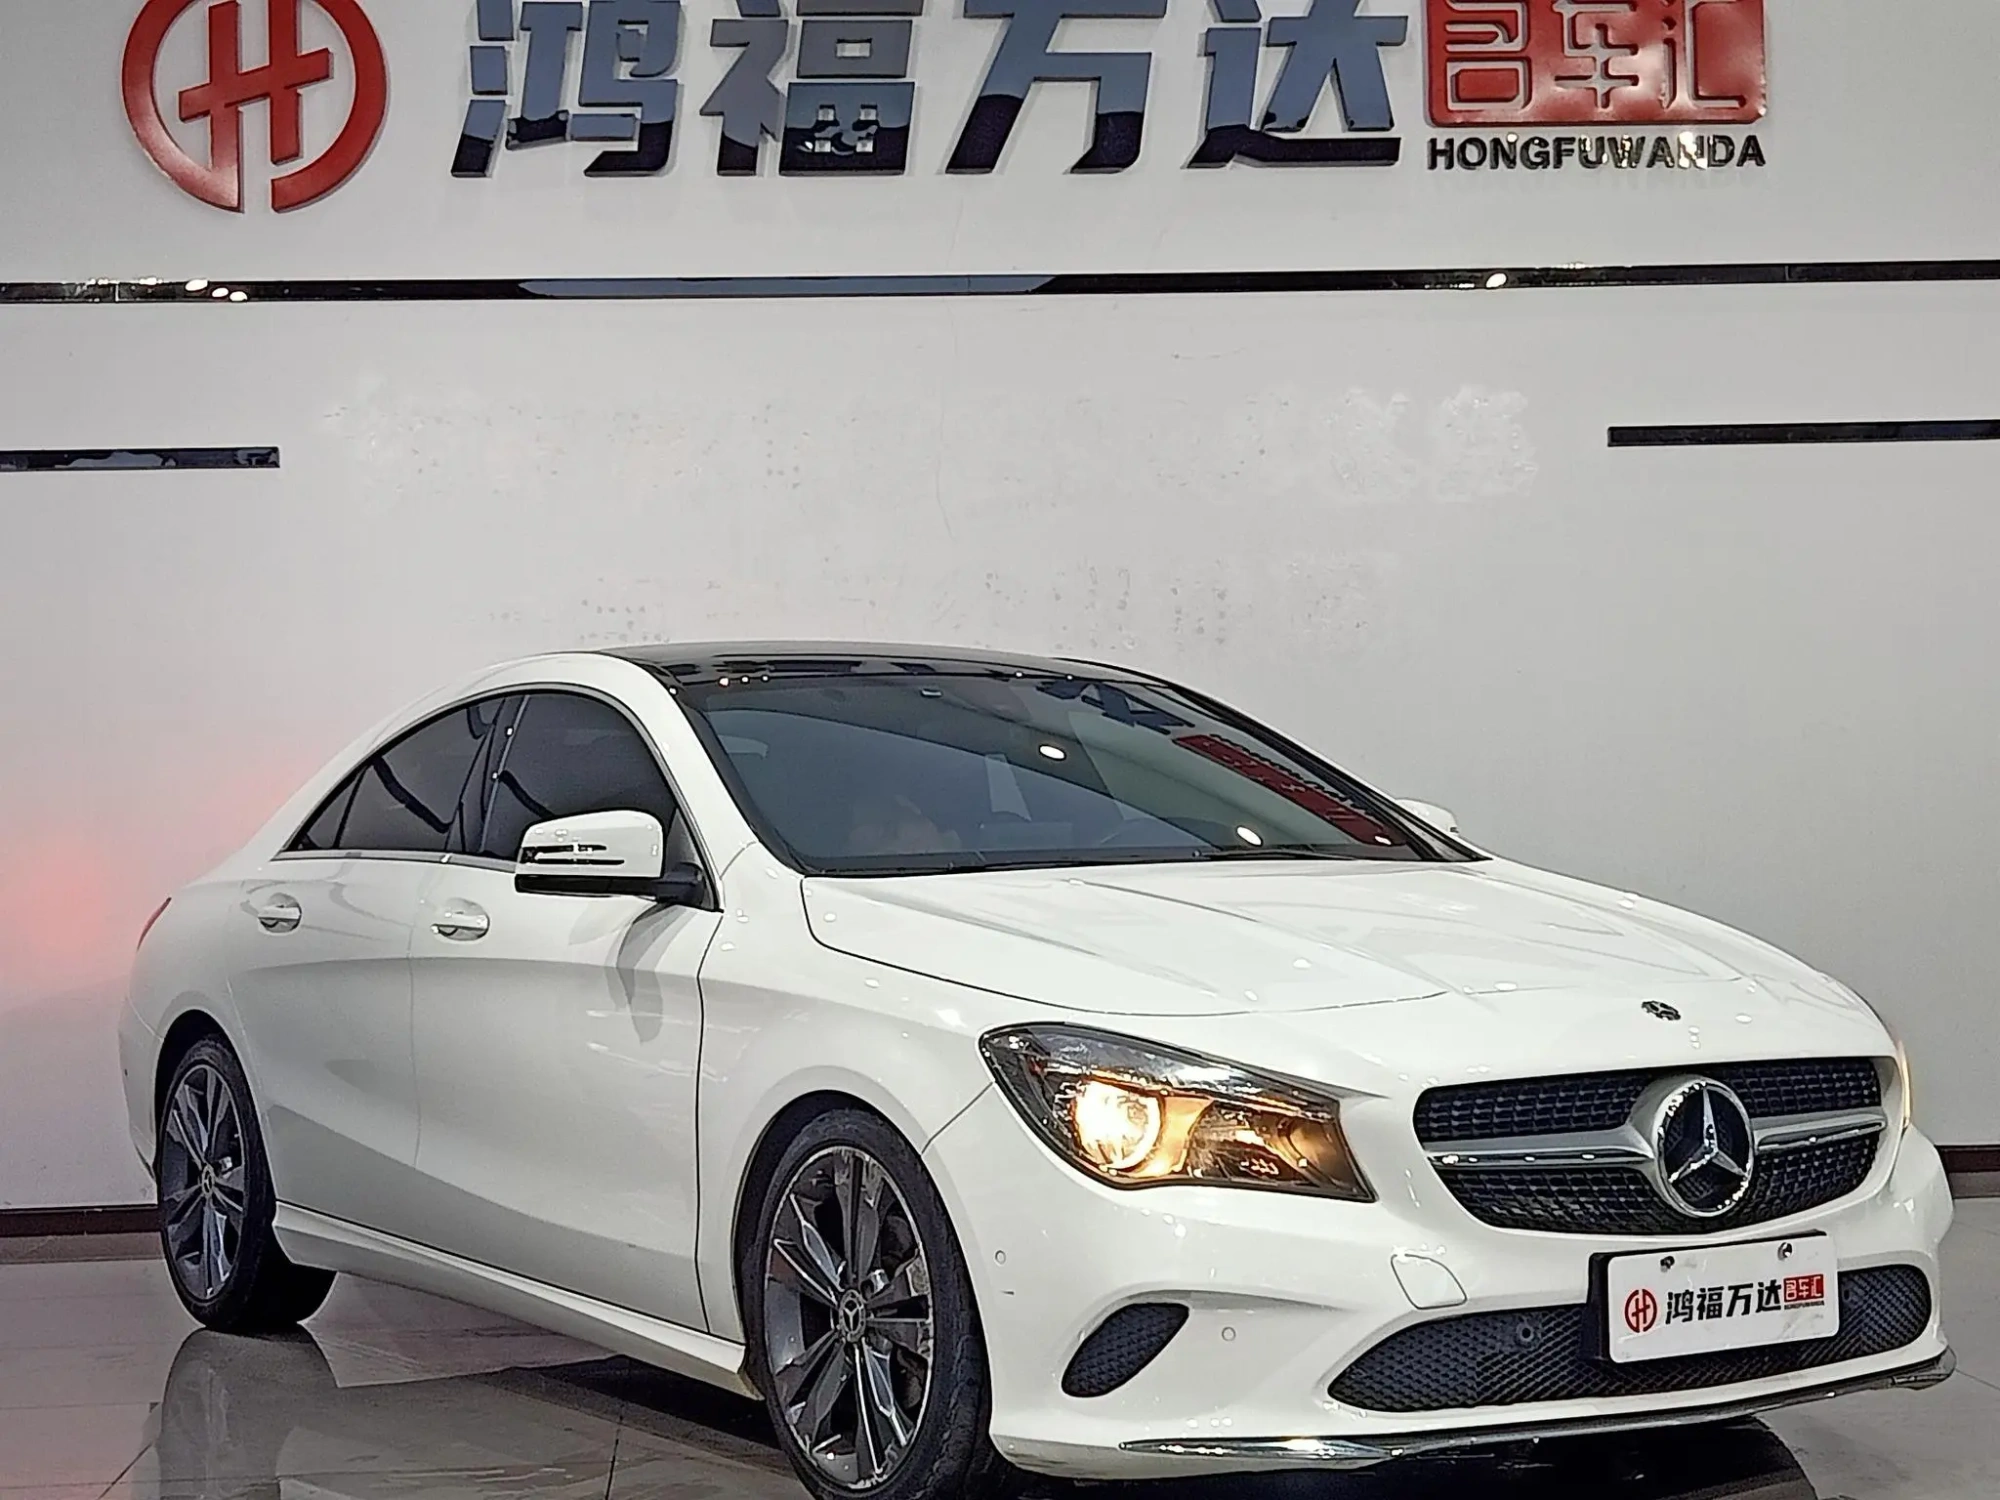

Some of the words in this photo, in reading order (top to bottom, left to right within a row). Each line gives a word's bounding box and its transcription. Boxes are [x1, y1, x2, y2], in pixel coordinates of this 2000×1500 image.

[451, 0, 1407, 177] 鸿福万达
[1427, 132, 1766, 170] HONGFUWANDA
[1665, 1280, 1782, 1324] 鸿福万达
